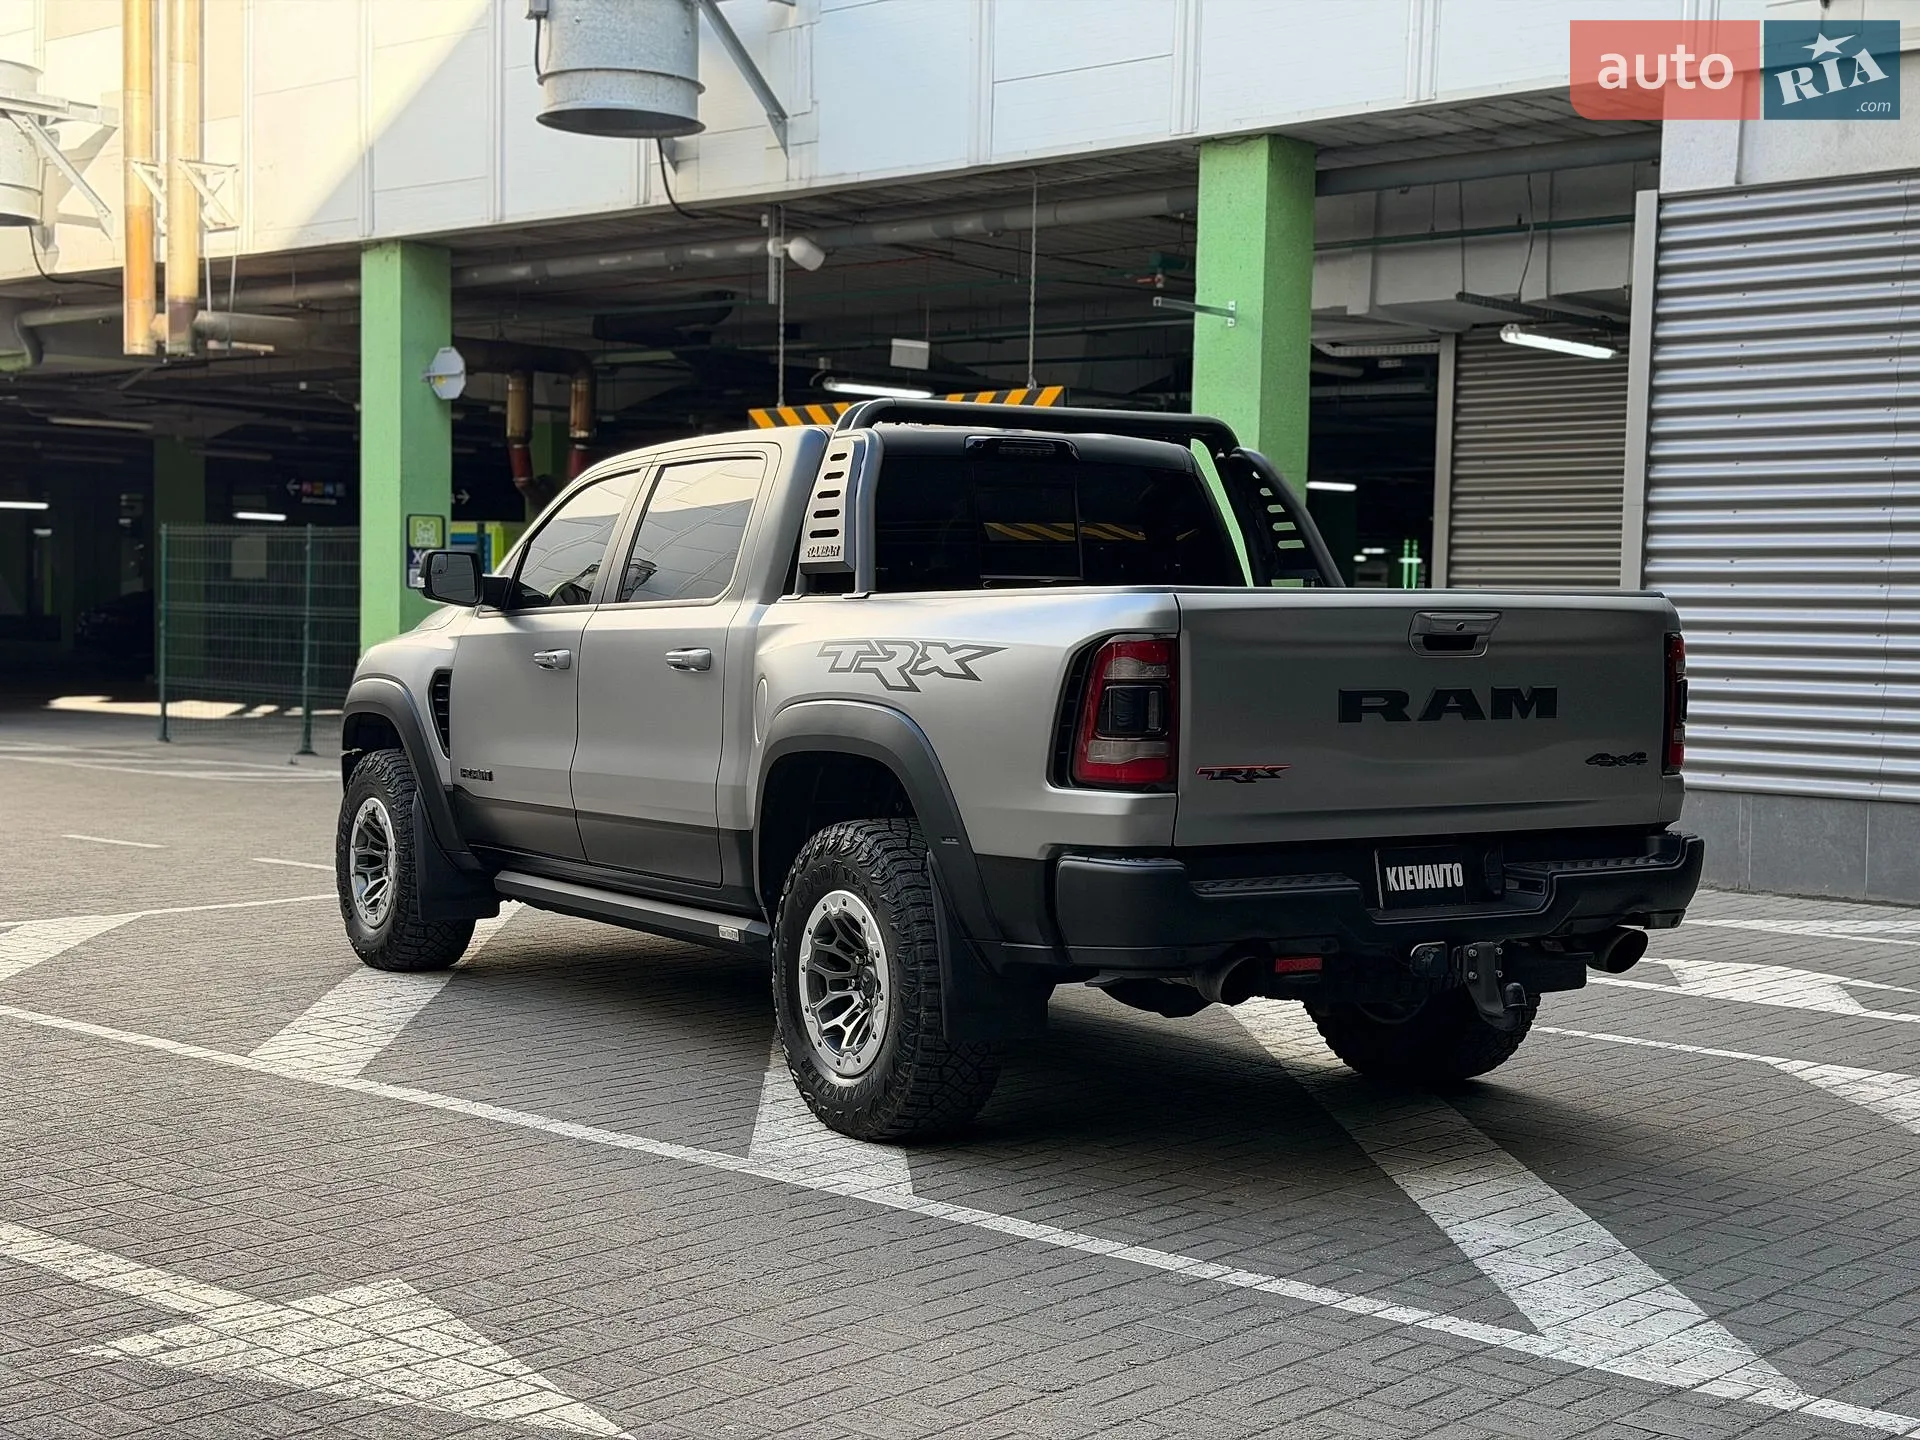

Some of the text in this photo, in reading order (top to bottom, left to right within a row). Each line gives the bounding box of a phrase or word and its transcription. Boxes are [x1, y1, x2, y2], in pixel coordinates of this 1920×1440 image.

[816, 639, 1009, 692] TRX
[1338, 686, 1558, 723] RAM
[1196, 764, 1292, 783] TRX
[1386, 863, 1464, 891] KIEVAVTO
